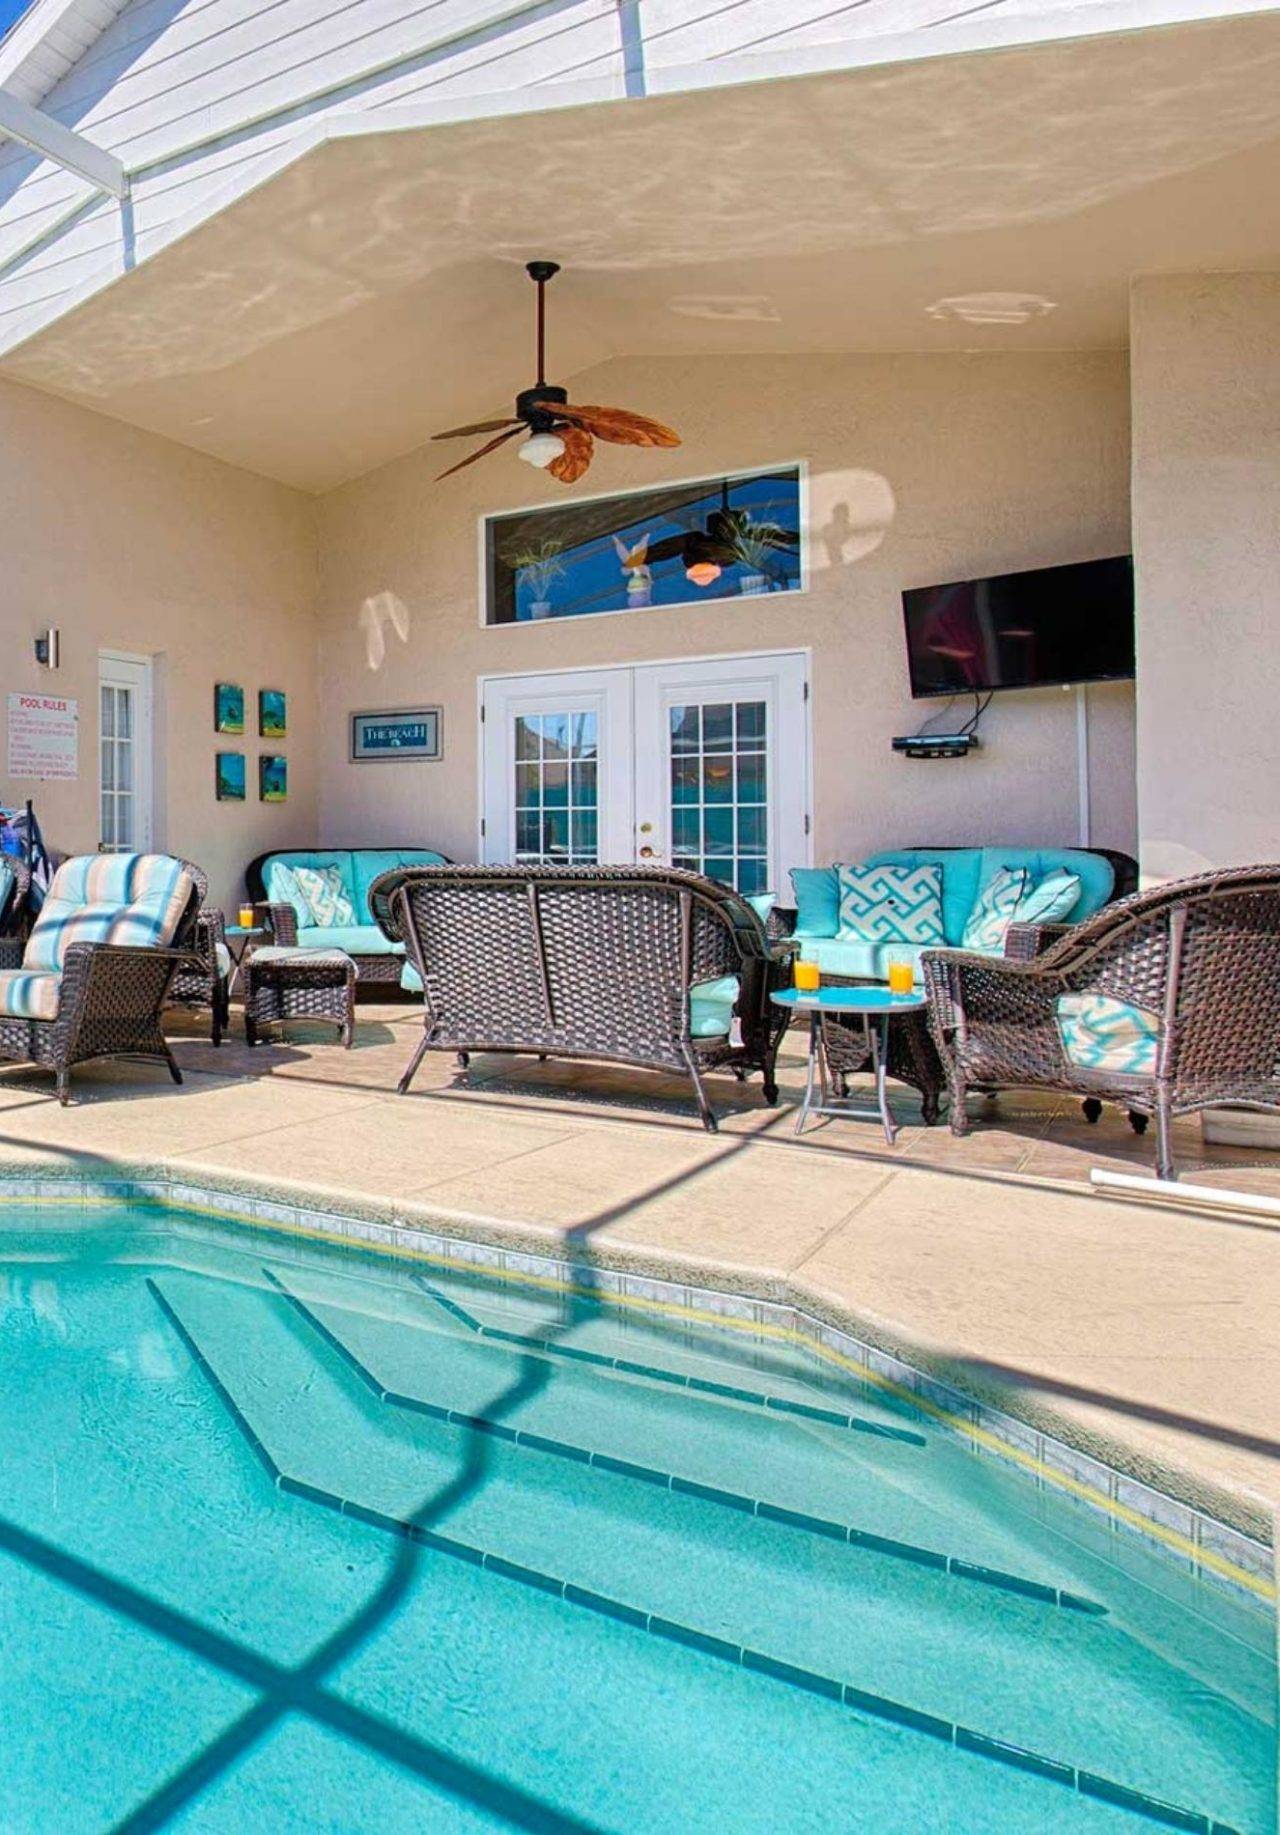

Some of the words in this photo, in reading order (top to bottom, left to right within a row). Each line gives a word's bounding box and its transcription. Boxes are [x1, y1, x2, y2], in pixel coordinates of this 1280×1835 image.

[20, 697, 41, 709] POOL
[43, 700, 67, 711] RULES
[367, 728, 387, 740] THE
